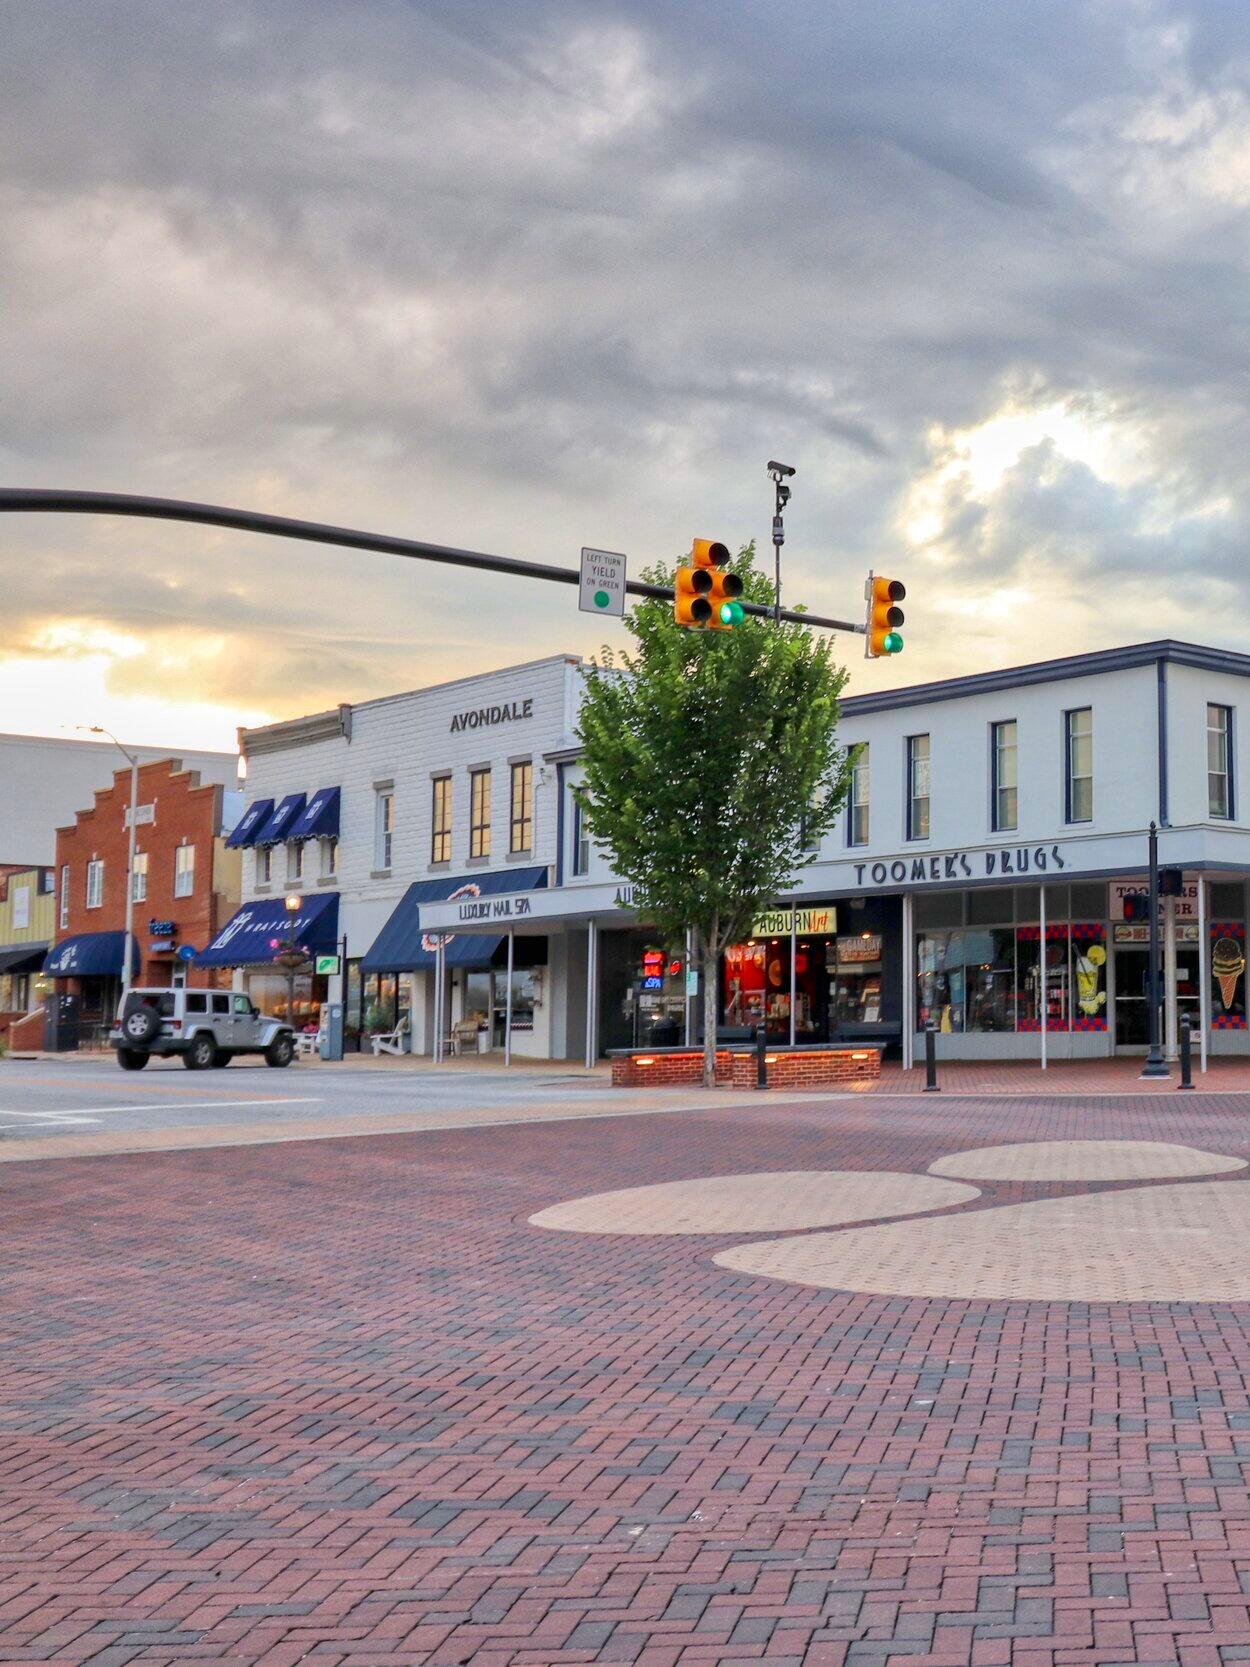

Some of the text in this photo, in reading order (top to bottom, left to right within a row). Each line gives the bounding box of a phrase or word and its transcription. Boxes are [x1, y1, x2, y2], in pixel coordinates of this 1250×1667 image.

[586, 554, 621, 566] LEFT TURN
[592, 565, 616, 579] YIELD
[586, 577, 620, 590] ON GREEN
[449, 698, 534, 733] AVONDALE
[853, 845, 1065, 885] TOOMER'S DRUGS
[459, 898, 531, 920] LUXURY NAIL SPA
[759, 911, 811, 933] AUBURN
